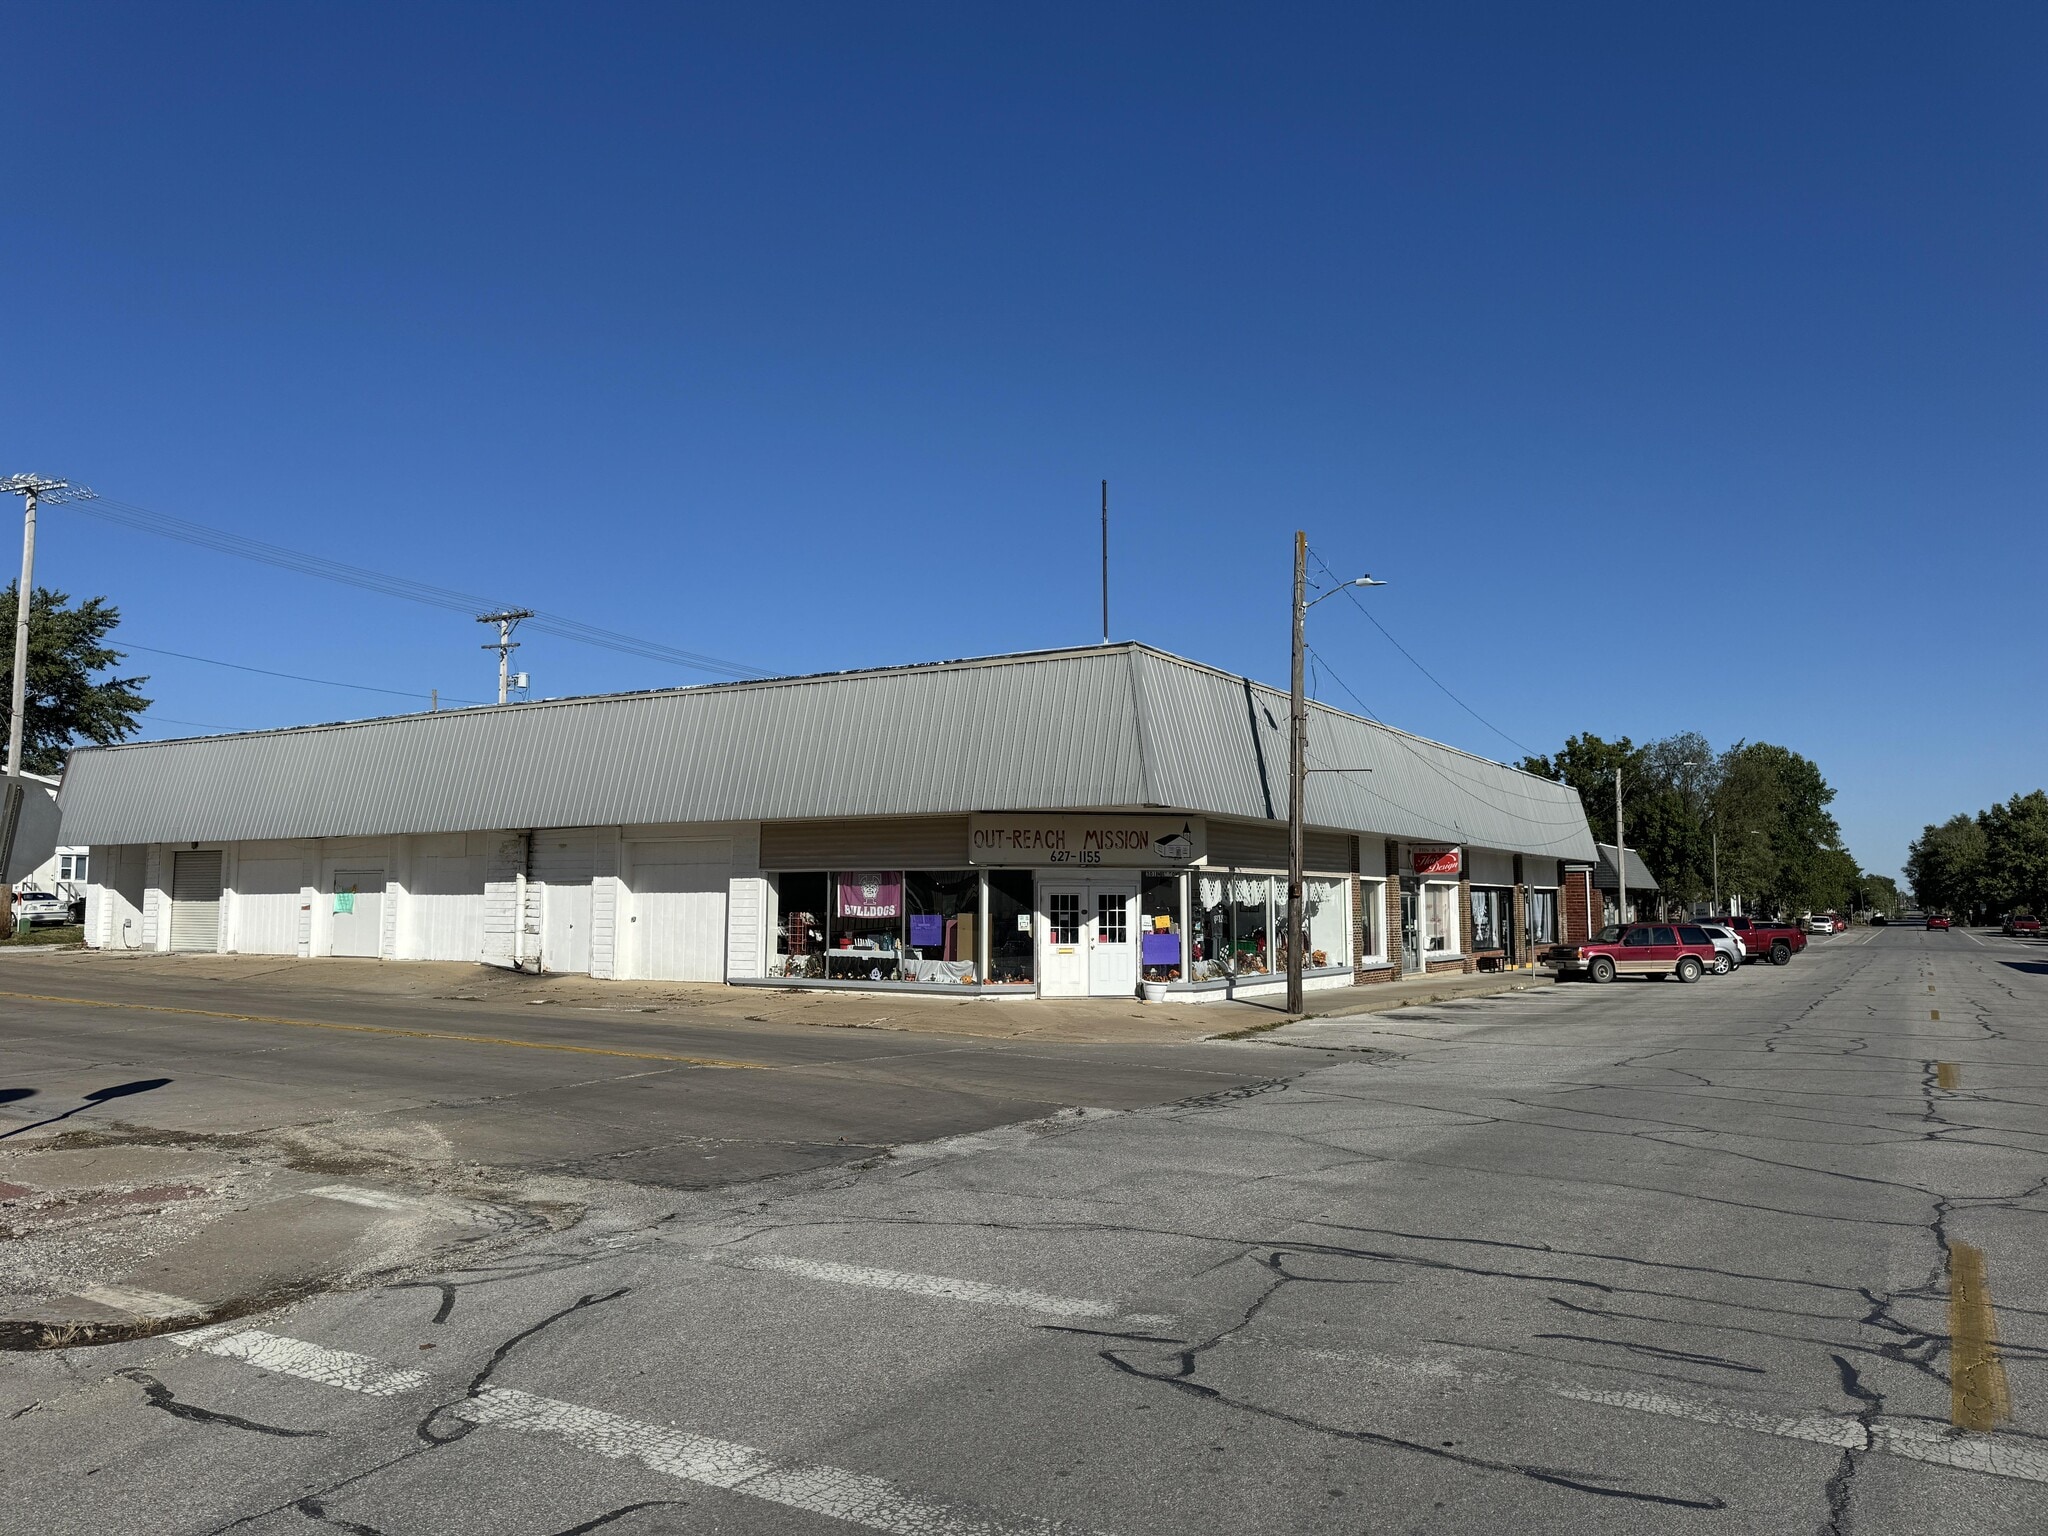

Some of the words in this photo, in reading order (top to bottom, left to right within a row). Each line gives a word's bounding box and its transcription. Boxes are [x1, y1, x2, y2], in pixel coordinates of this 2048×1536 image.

[974, 829, 1065, 849] OUT-REACH
[1083, 830, 1148, 850] MISSION
[1050, 851, 1100, 863] 627-1155
[1428, 861, 1458, 872] Design
[844, 904, 896, 916] BULLDOGS
